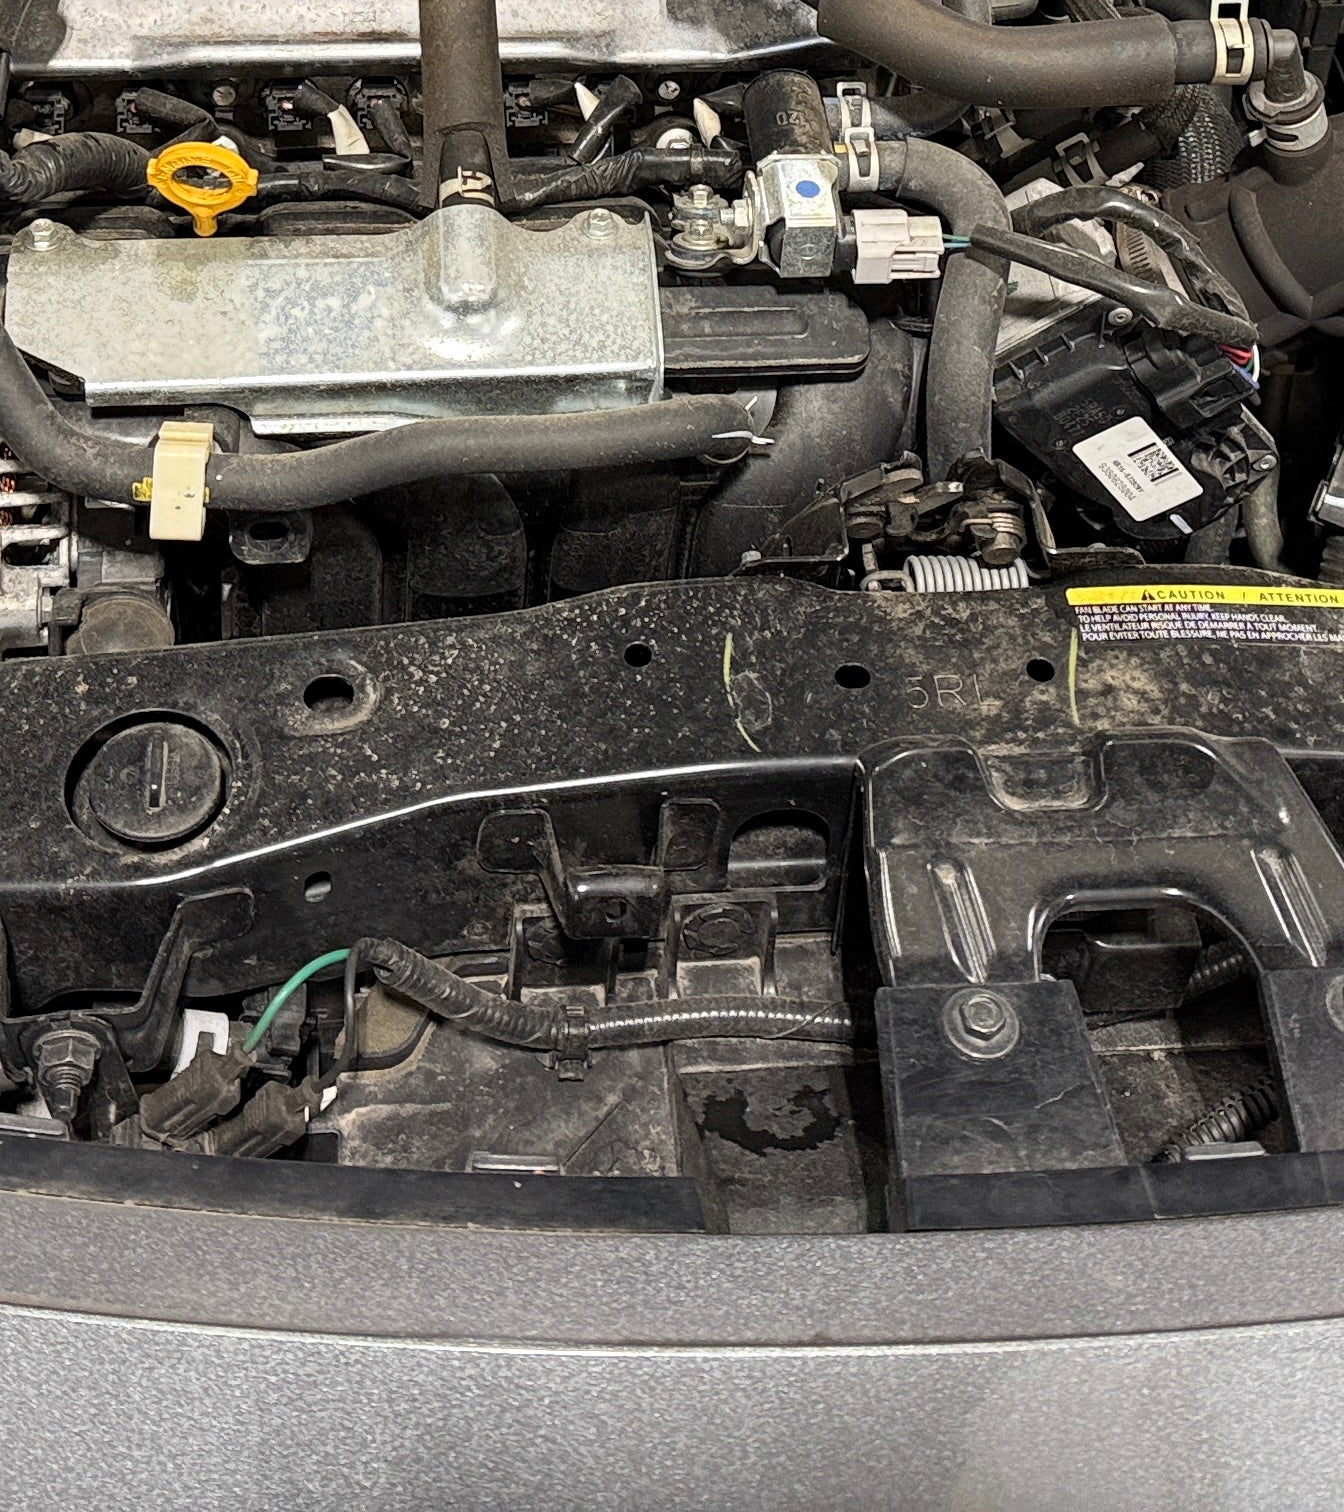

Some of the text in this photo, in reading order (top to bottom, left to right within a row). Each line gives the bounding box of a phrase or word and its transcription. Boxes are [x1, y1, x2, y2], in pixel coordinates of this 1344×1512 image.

[1157, 590, 1225, 601] CAUTION
[1259, 592, 1340, 603] ATTENTION
[1075, 606, 1091, 614] FAN
[1093, 605, 1119, 614] BLADE
[1120, 605, 1138, 613] CAN
[1138, 604, 1163, 612] START
[1176, 604, 1193, 612] ANY
[1078, 615, 1090, 623] TO
[1091, 615, 1111, 623] HELP
[1113, 614, 1138, 622] AVOID
[1139, 613, 1182, 621] PERSONAL
[1213, 613, 1230, 621] KEEP
[1231, 614, 1259, 622] HANDS
[1080, 624, 1091, 632] LE
[1091, 623, 1150, 631] VENTILATEUR
[1151, 621, 1183, 630] RISQUE
[1185, 621, 1197, 629] DE
[1253, 622, 1277, 630] TOUT
[1082, 632, 1108, 641] POUR
[1142, 630, 1169, 639] TOUTE
[1216, 631, 1229, 639] NE
[1230, 631, 1246, 639] PAS
[1247, 631, 1260, 639] EN
[1261, 632, 1313, 641] APPROCHER
[1313, 633, 1329, 642] LES
[904, 673, 1001, 709] 5RL
